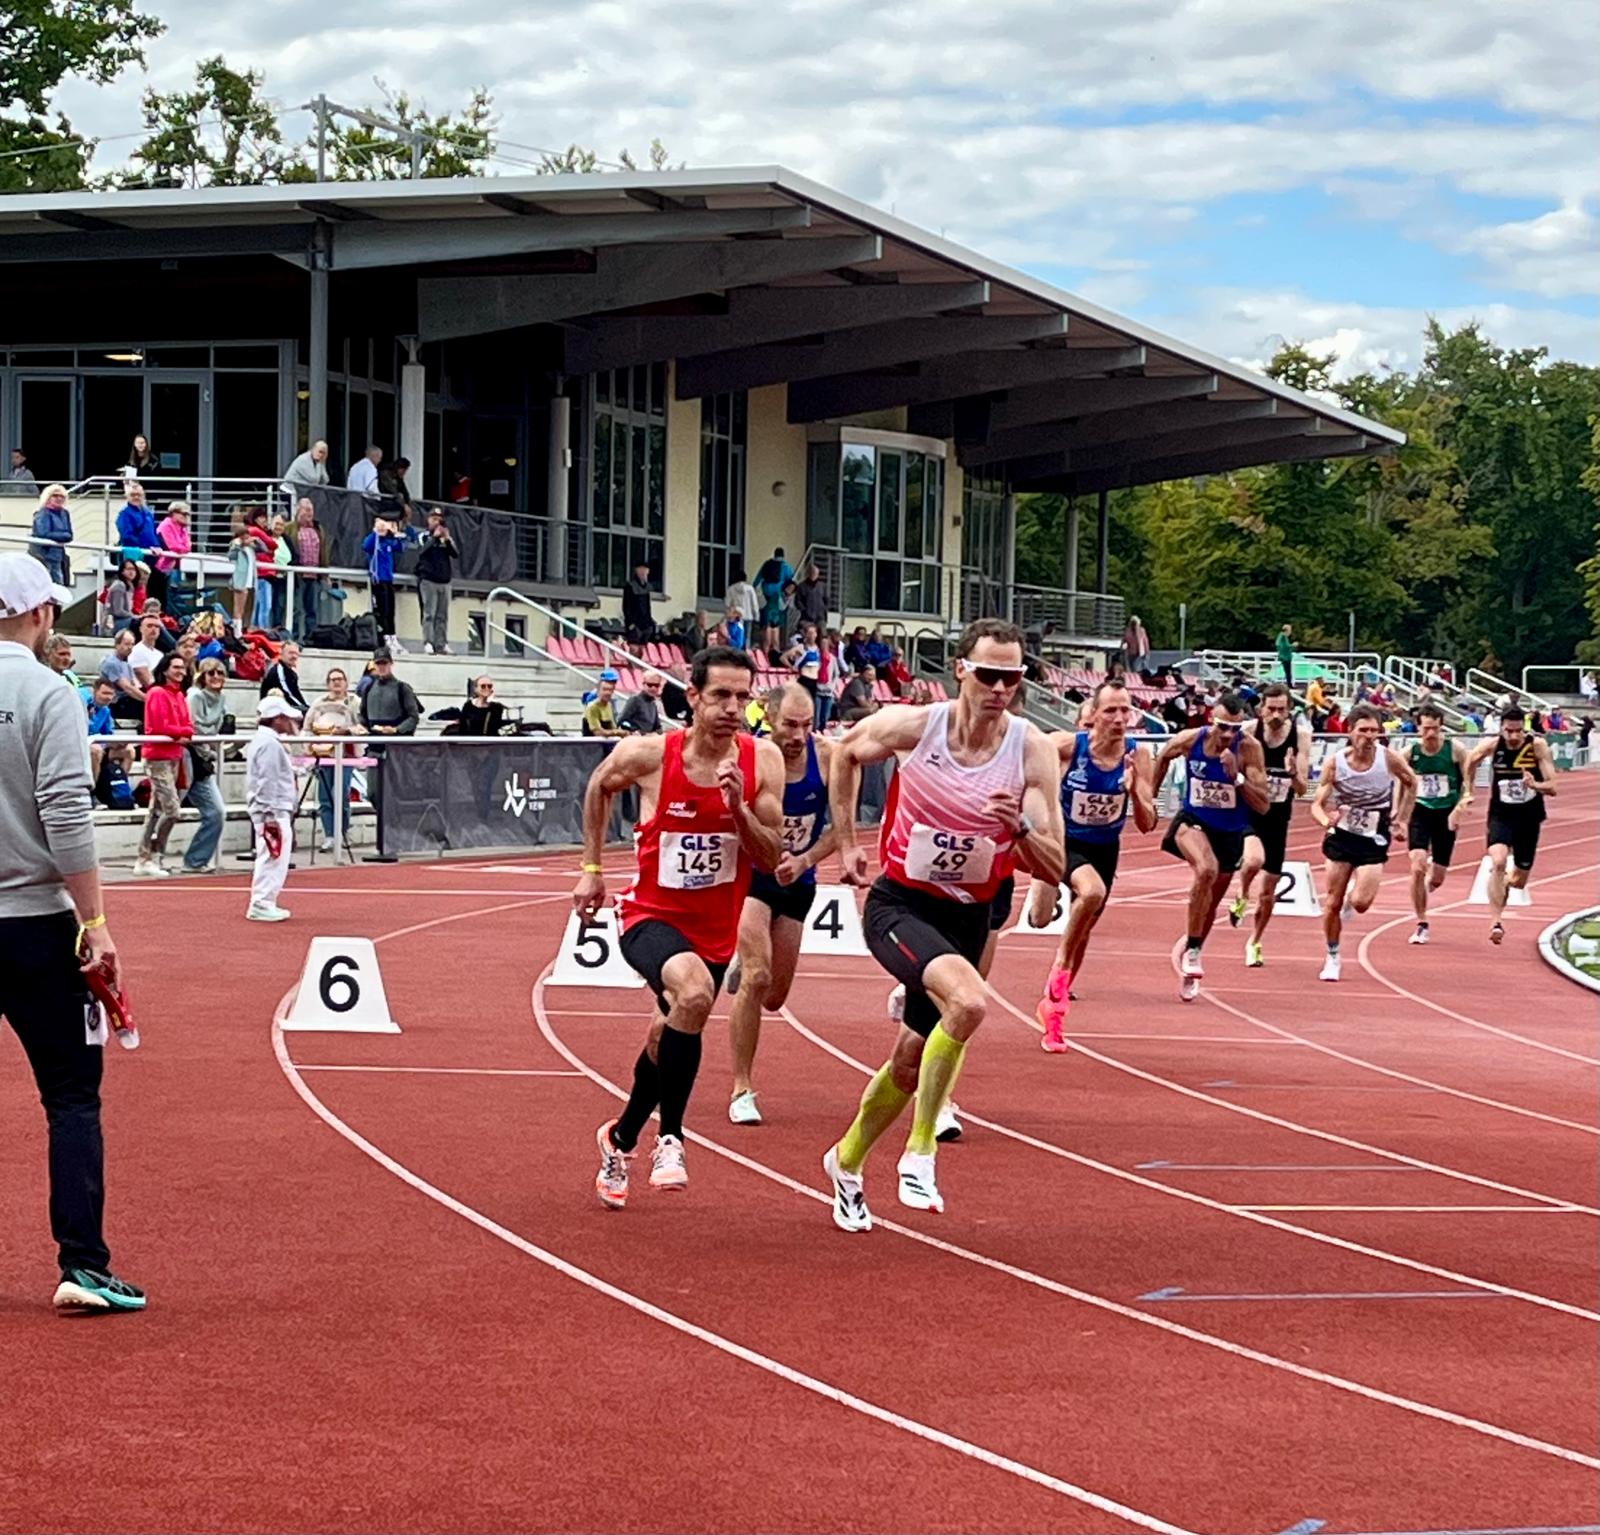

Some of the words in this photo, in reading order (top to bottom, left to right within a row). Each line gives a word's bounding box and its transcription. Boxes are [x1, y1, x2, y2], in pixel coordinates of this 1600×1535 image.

[784, 817, 802, 828] LS
[680, 835, 721, 851] GLS
[783, 828, 807, 843] 47
[933, 832, 975, 851] GLS
[677, 852, 722, 873] 145
[932, 851, 967, 871] 49
[1274, 871, 1296, 903] 2
[812, 899, 844, 939] 4
[573, 921, 610, 968] 5
[319, 955, 361, 1013] 6
